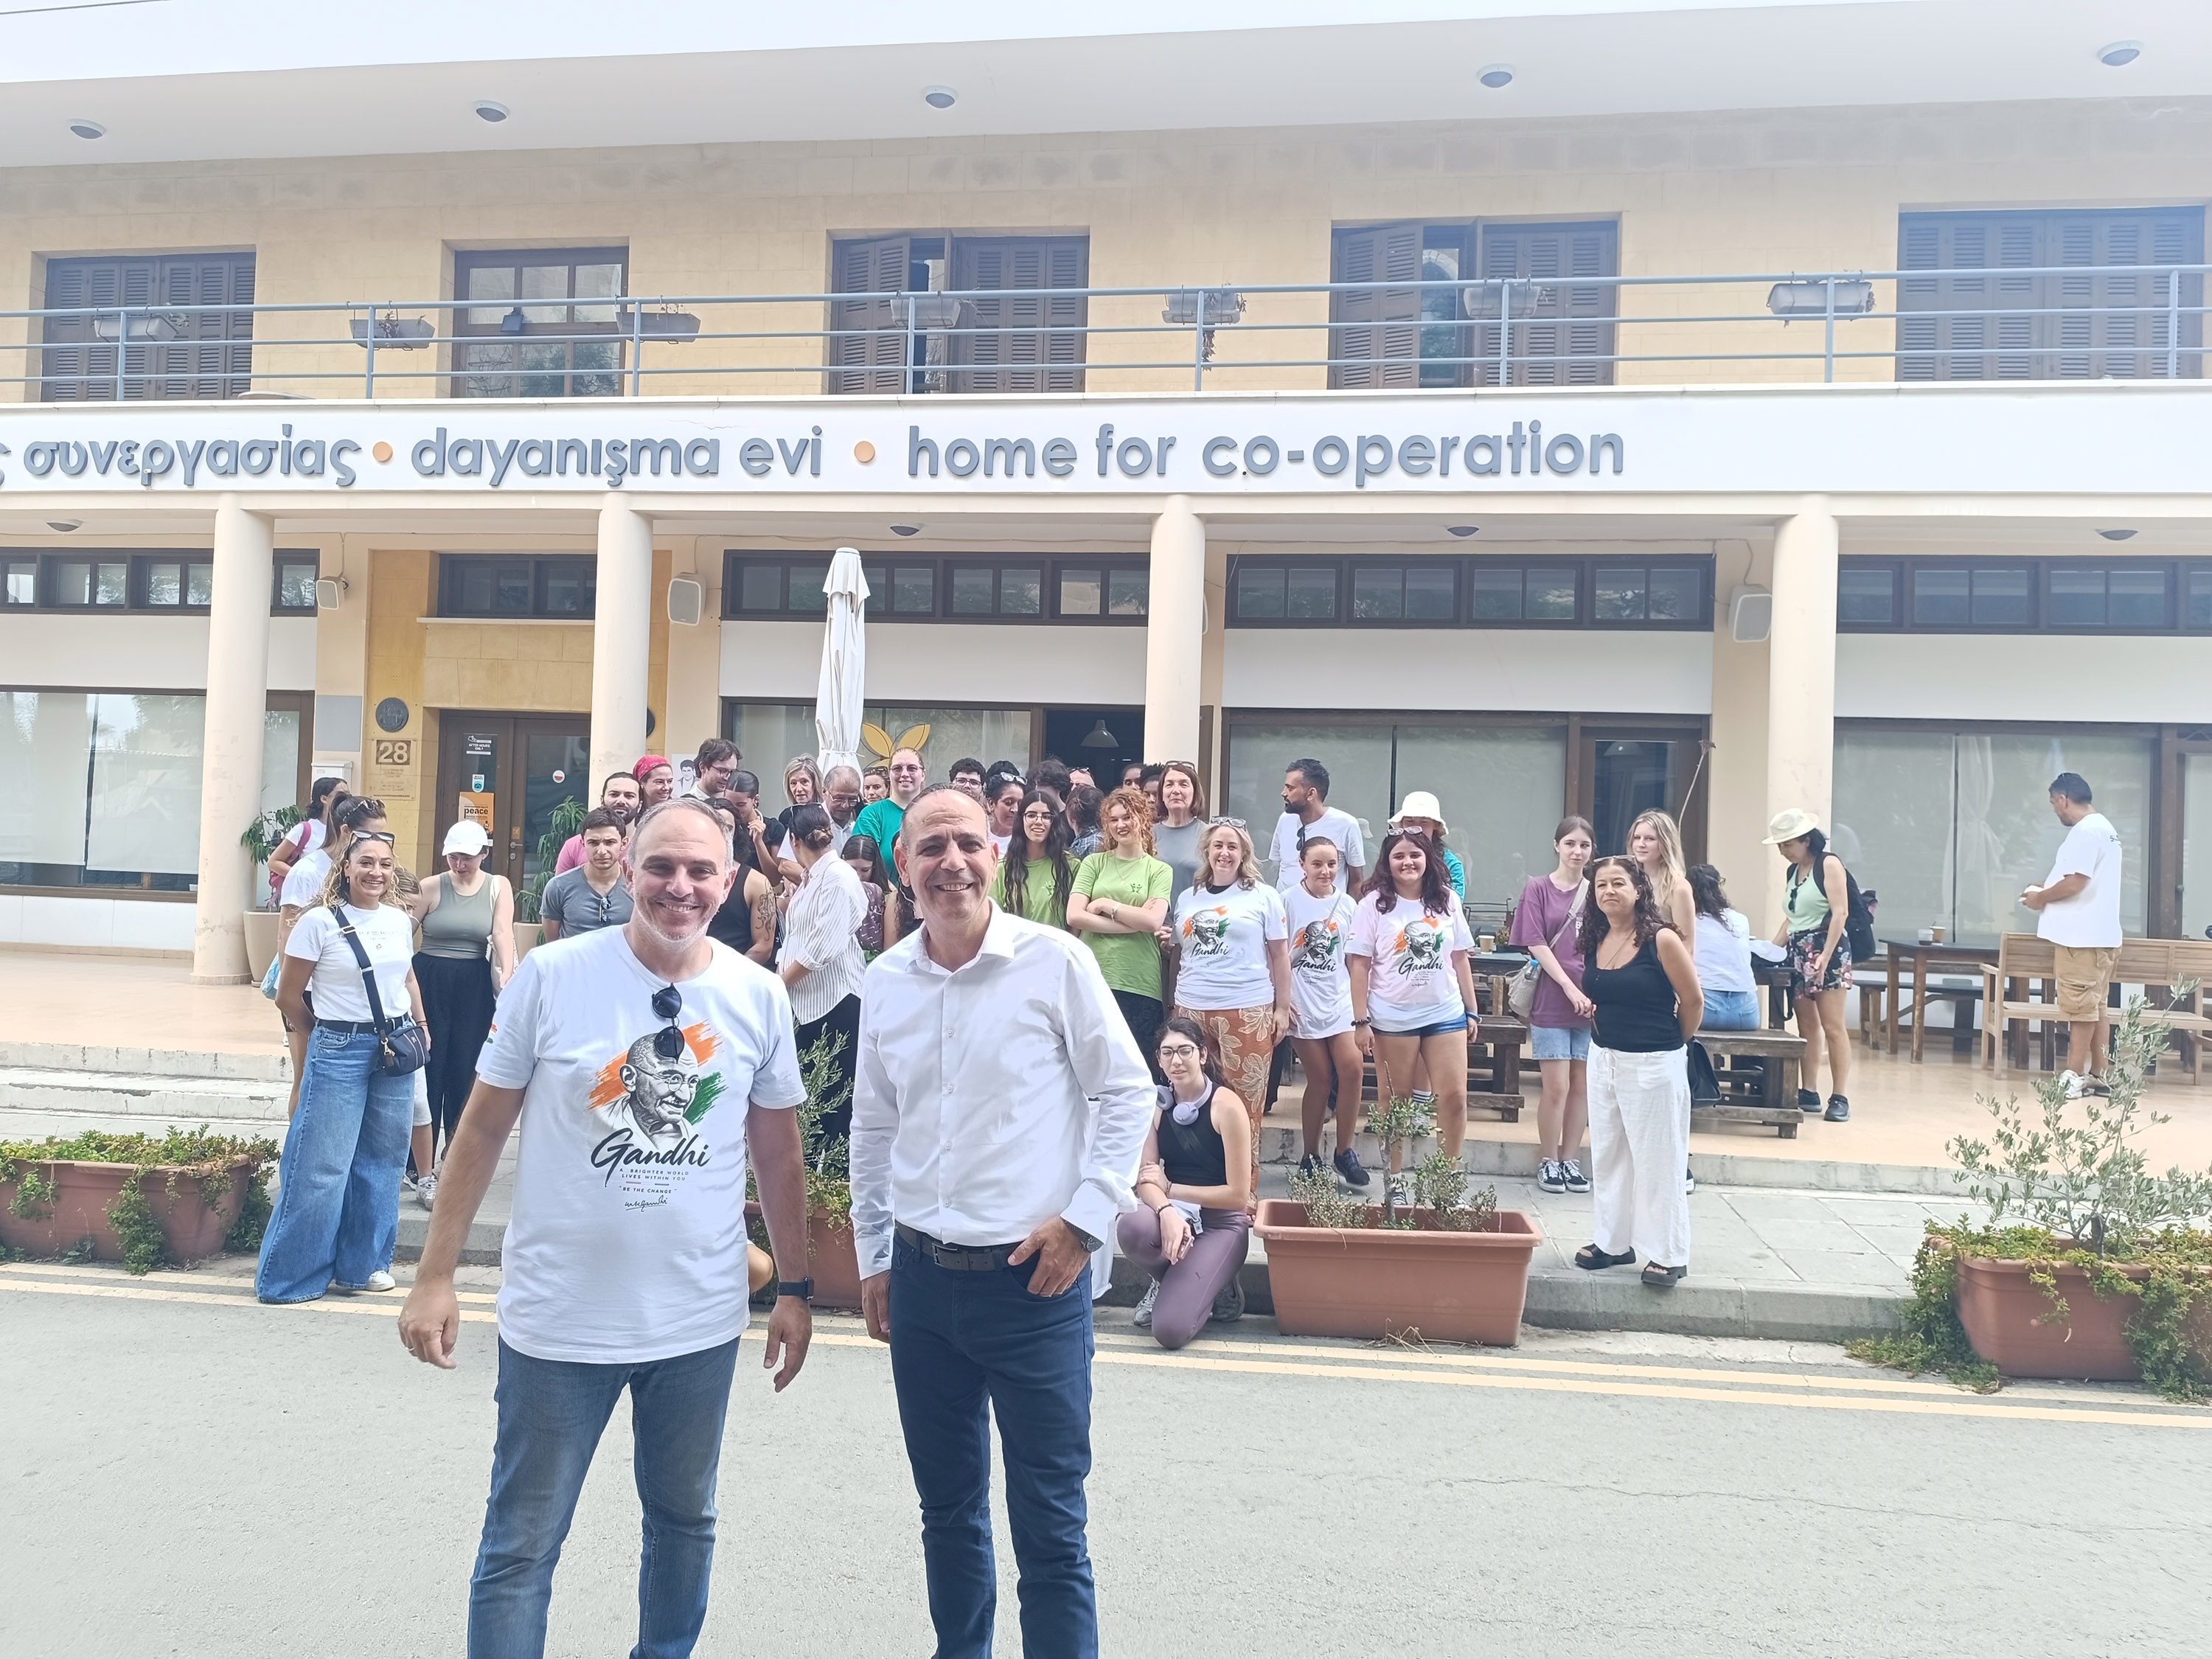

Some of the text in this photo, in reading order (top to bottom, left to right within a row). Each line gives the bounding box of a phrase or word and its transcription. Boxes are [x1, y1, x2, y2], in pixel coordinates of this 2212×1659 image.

[24, 423, 362, 488] συνεργασίας
[409, 425, 823, 489] dayanışma evi
[908, 419, 1624, 489] home for co-operation
[378, 742, 408, 763] 28
[464, 808, 488, 819] peace
[1189, 942, 1231, 961] Gandhi
[1293, 953, 1337, 975] Gandhi
[1398, 956, 1444, 981] Gandhi
[591, 1127, 712, 1188] Gandhi
